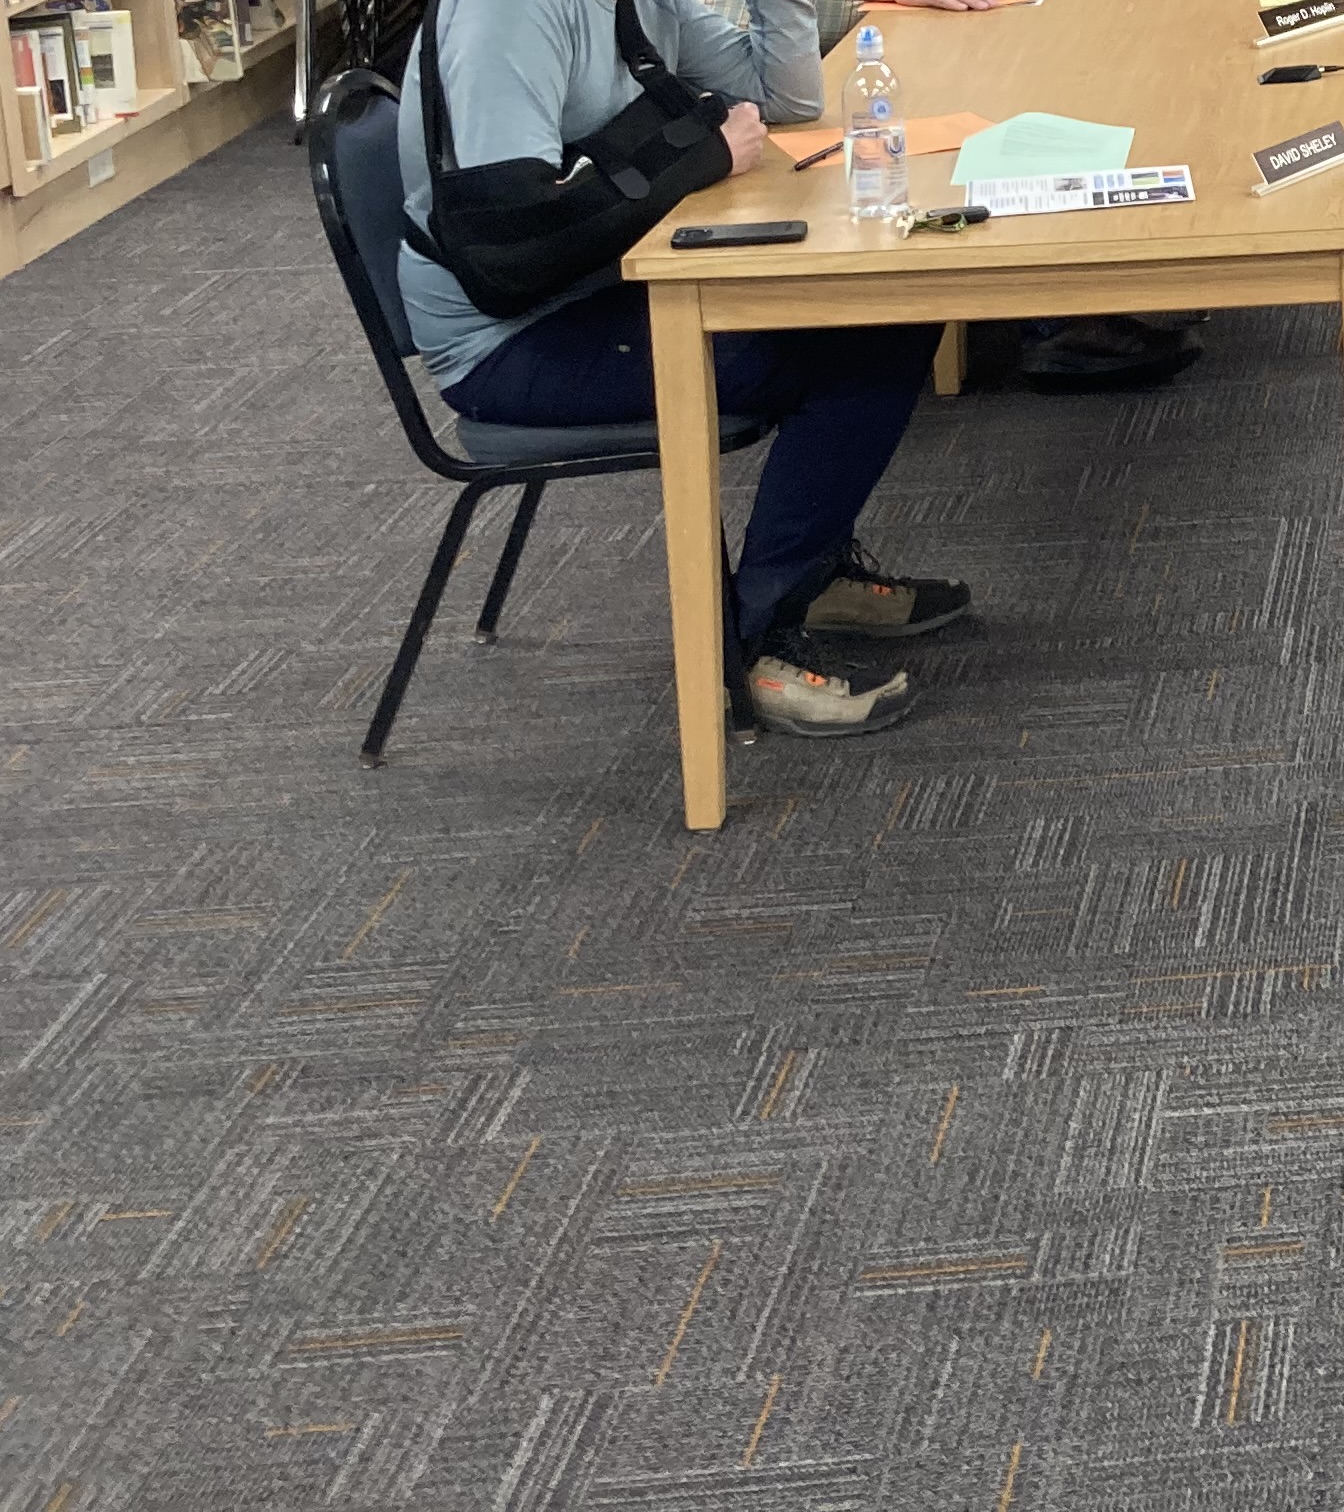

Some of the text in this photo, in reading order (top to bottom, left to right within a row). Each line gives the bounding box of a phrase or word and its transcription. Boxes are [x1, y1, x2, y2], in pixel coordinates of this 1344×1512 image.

[1275, 12, 1301, 27] Roger
[1309, 1, 1337, 18] Hoplin
[1269, 132, 1337, 170] DAVID SHELEY
